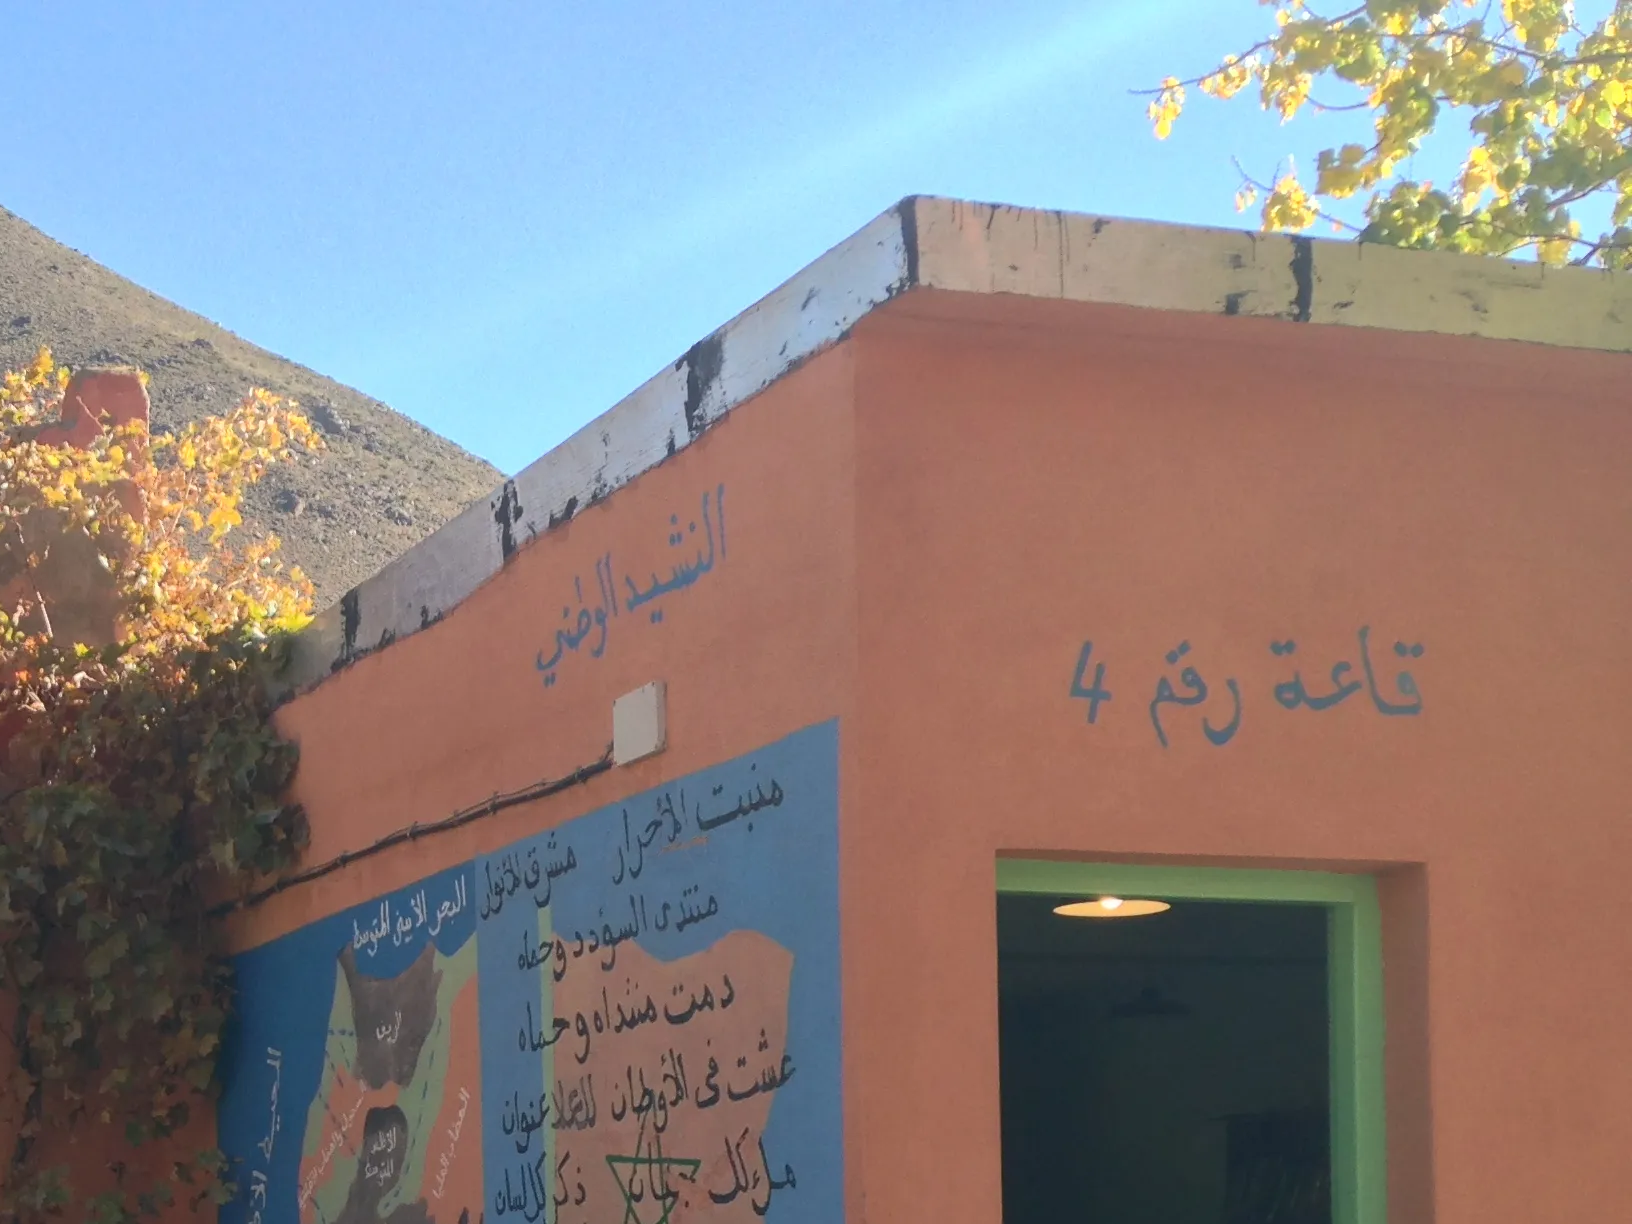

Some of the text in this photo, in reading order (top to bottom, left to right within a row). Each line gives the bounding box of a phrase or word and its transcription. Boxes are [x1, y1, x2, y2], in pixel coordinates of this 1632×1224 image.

[535, 482, 727, 688] النشيد الوطني
[1069, 625, 1424, 748] قاعة رقم 4
[612, 789, 689, 885] الأحرار
[696, 762, 785, 833] منبت
[523, 831, 578, 909] مشرق
[654, 884, 719, 933] منتدى
[352, 873, 467, 957] البحر الأبيض المتوسط
[517, 929, 567, 982] وحماه
[518, 974, 736, 1064] دمت منتداه وحماه
[610, 1047, 690, 1134] الأوطان
[726, 1027, 797, 1101] عشت
[257, 1046, 282, 1165] المحيط
[501, 1090, 551, 1154] عنوان
[707, 1126, 750, 1204] كل
